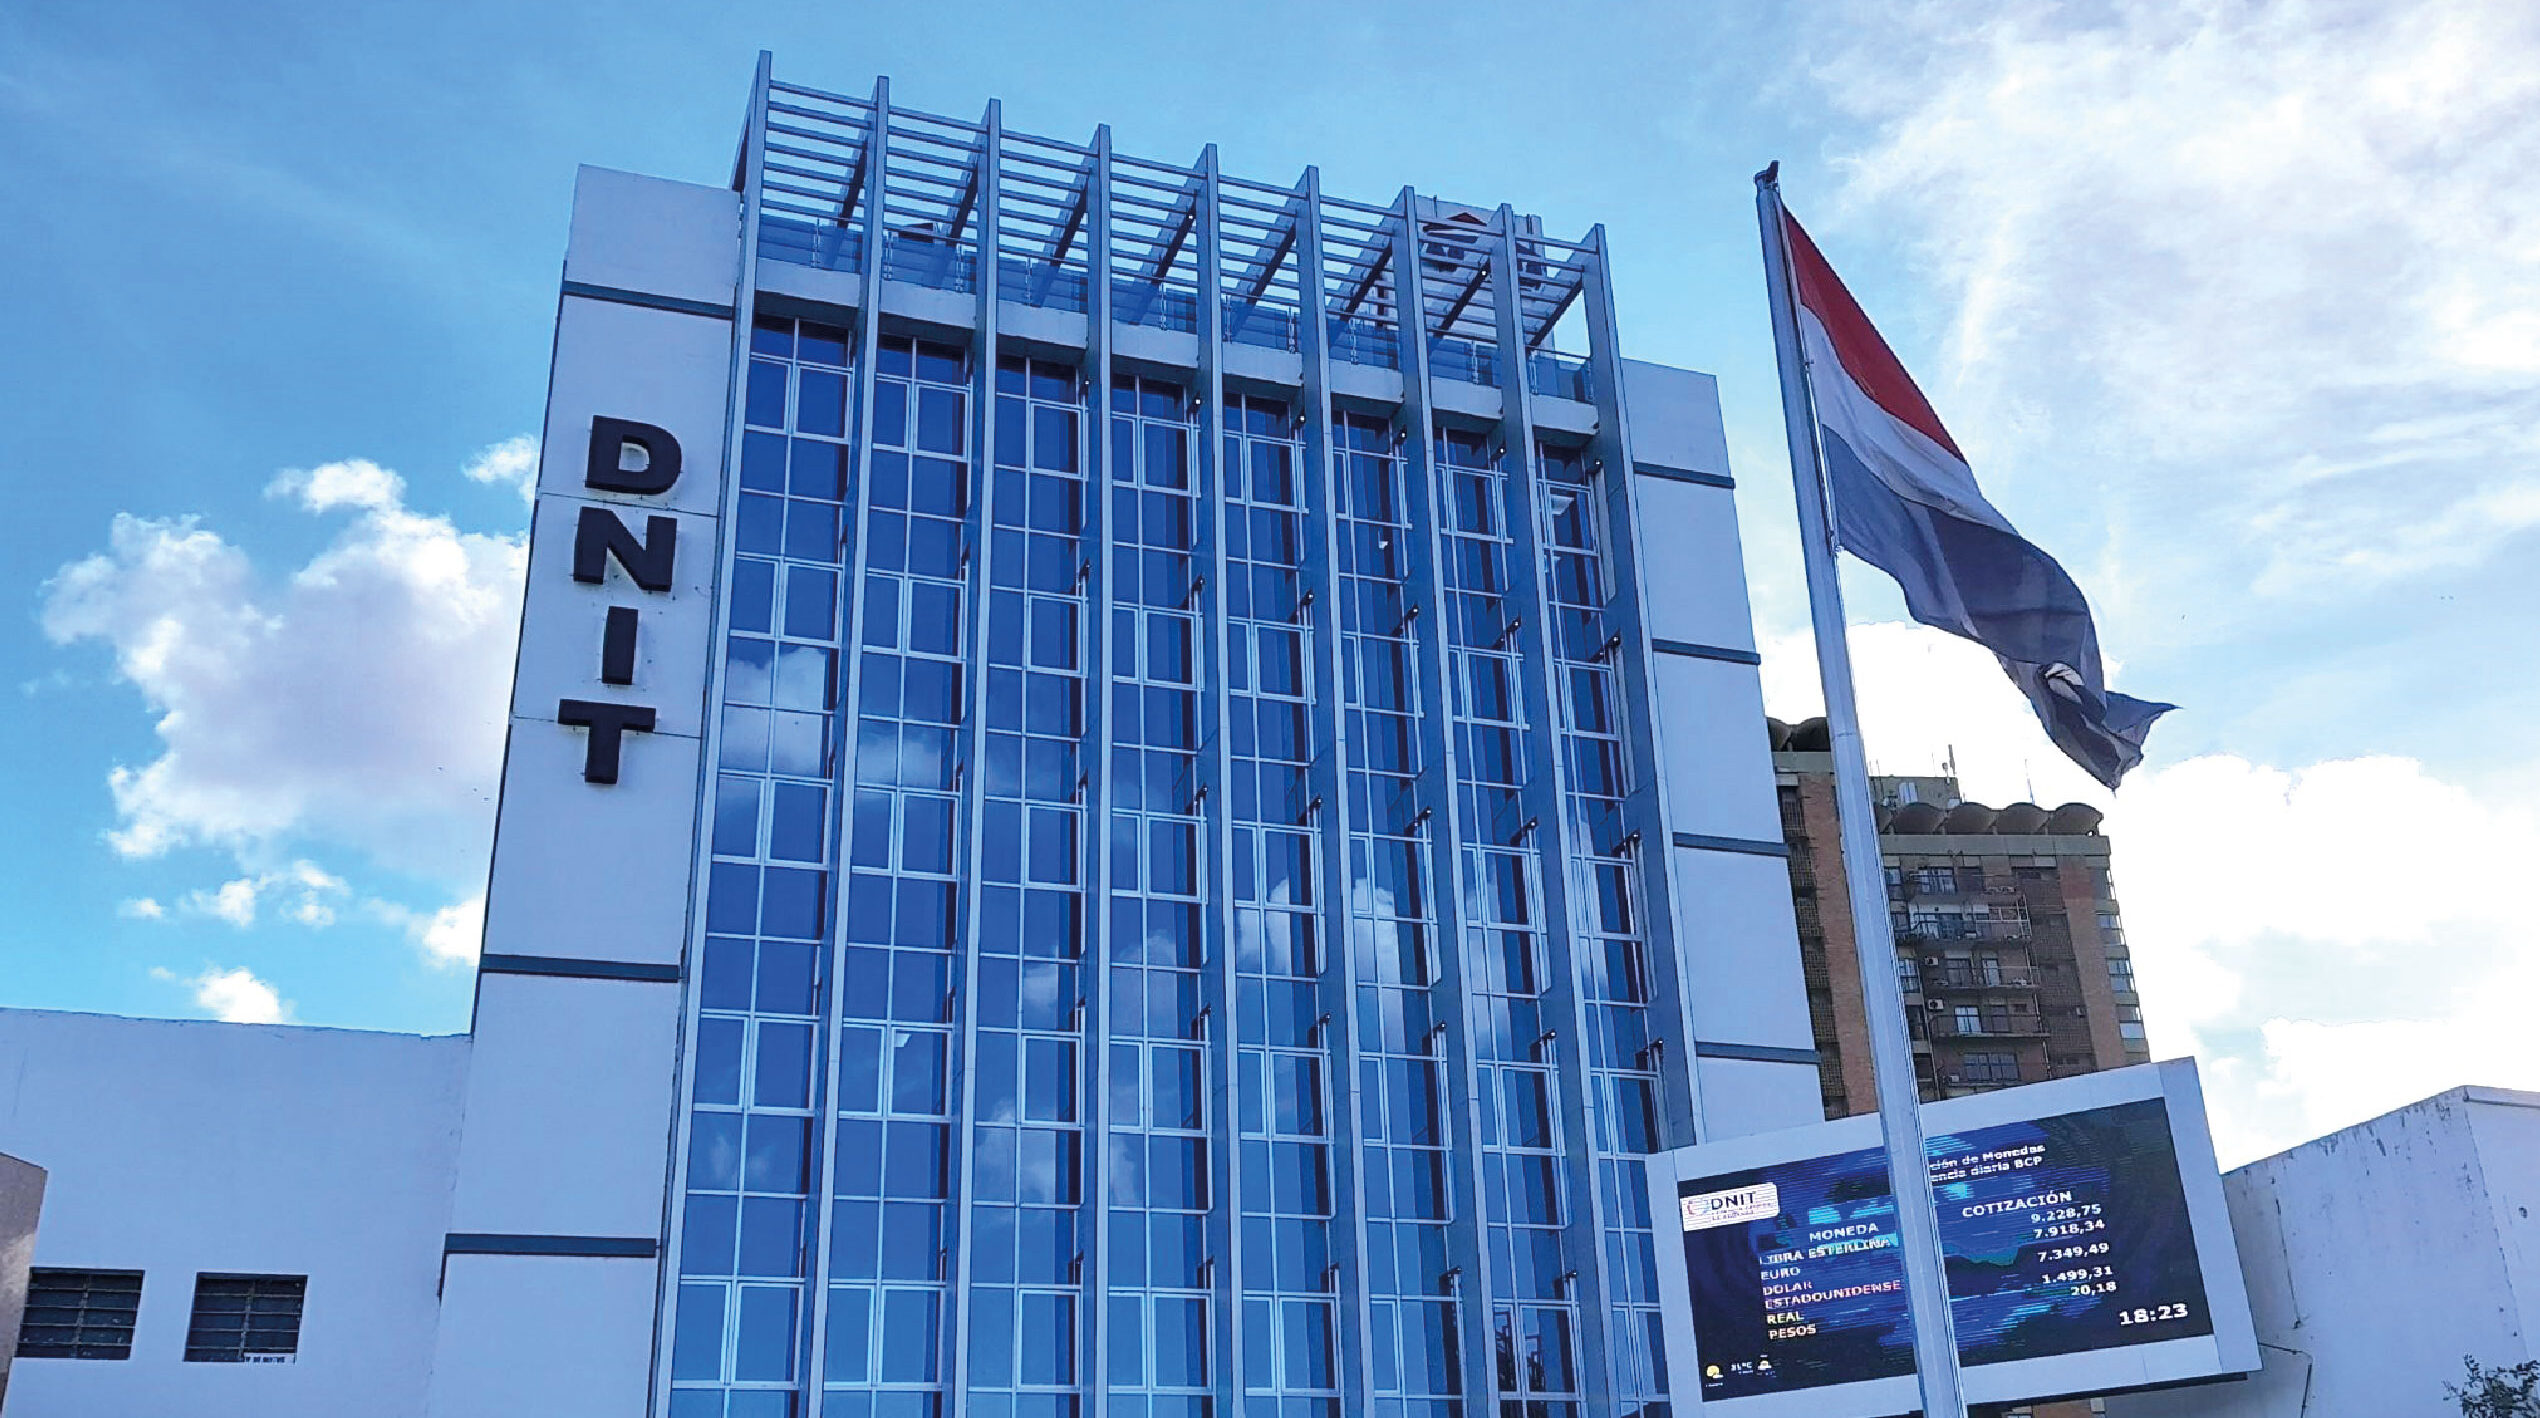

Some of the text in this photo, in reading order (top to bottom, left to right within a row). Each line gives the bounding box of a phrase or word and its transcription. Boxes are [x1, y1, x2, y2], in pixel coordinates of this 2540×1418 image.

[558, 415, 682, 784] DNIT
[1929, 1144, 2046, 1171] ción de Monedas
[1930, 1155, 2043, 1182] encia diaria BCP
[1711, 1191, 1756, 1211] DNIT
[1962, 1190, 2072, 1217] COTIZACIÓN
[2031, 1204, 2102, 1223] 9.228,75
[1809, 1223, 1880, 1242] MONEDA
[2033, 1219, 2106, 1239] 7.918,34
[1759, 1239, 1892, 1265] LIBRA ESTERLINA
[2037, 1242, 2110, 1262] 7.349,49
[1760, 1266, 1801, 1280] EURO
[2041, 1265, 2113, 1284] 1.499,31
[1762, 1281, 1813, 1296] DOLAR
[1764, 1280, 1902, 1309] ESTADOUNIDENSE
[2071, 1281, 2117, 1296] 20,18
[1766, 1311, 1805, 1325] REAL
[2119, 1303, 2189, 1326] 18:23
[1768, 1323, 1817, 1340] PESOS
